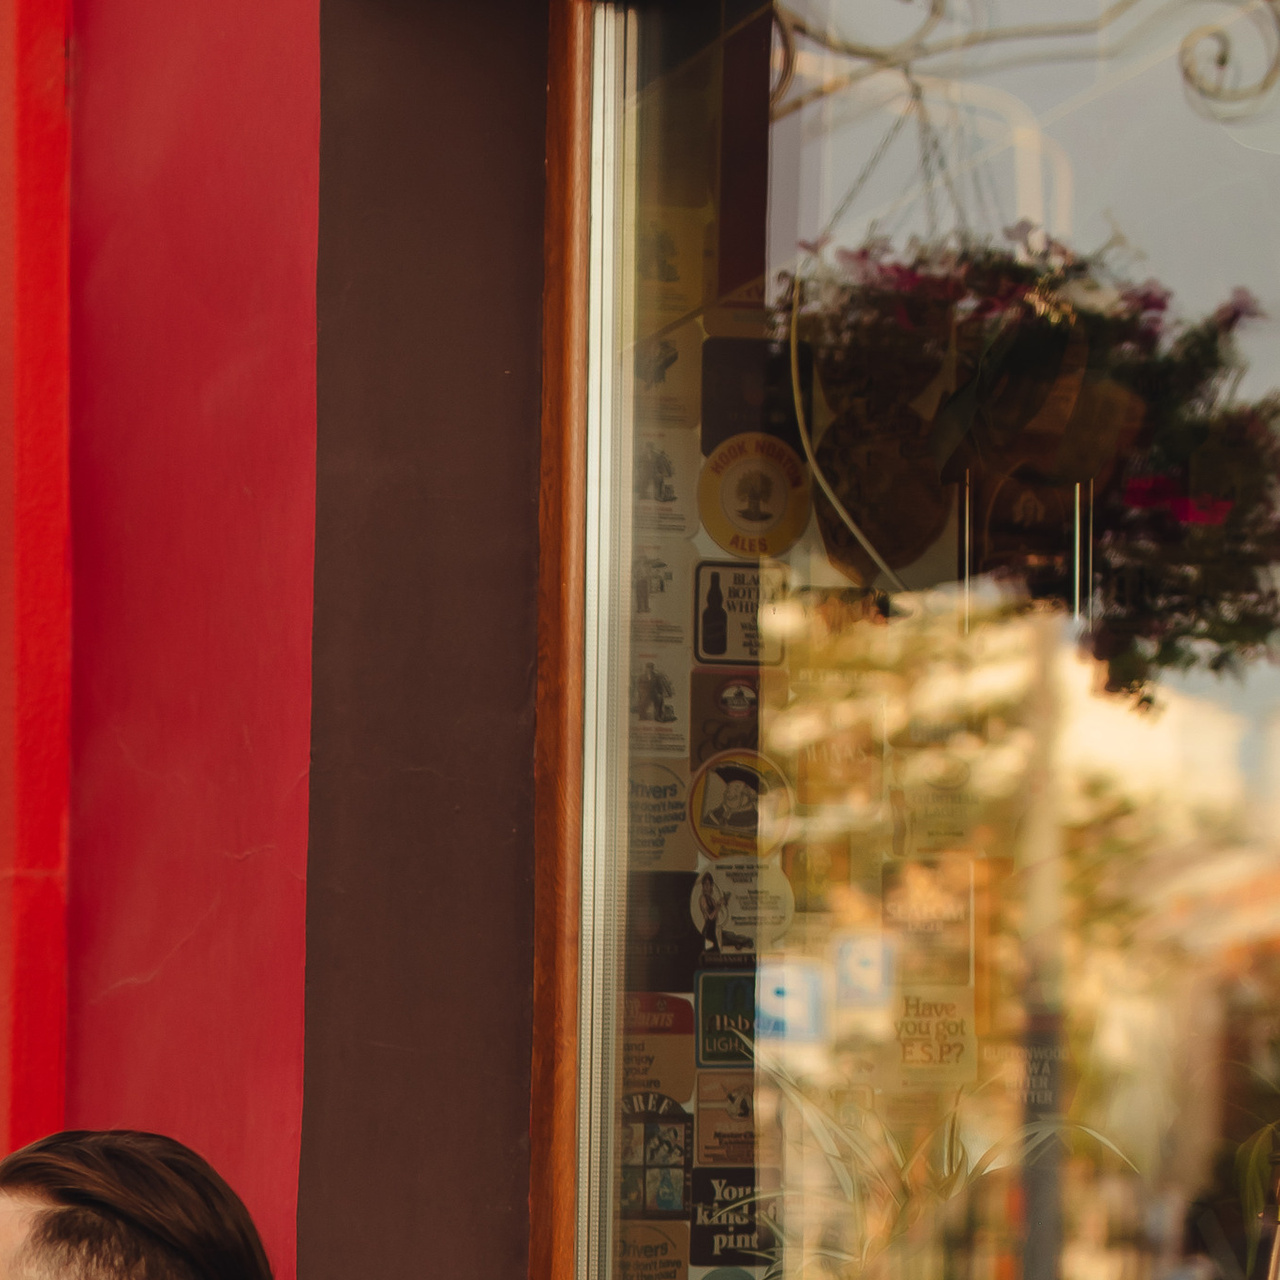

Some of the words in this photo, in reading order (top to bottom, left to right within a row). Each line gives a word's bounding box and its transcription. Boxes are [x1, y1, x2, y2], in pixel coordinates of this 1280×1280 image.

[729, 534, 769, 552] ALES
[904, 995, 956, 1018] Have
[895, 1020, 931, 1042] you
[935, 1018, 966, 1042] got
[713, 1226, 759, 1256] pint
